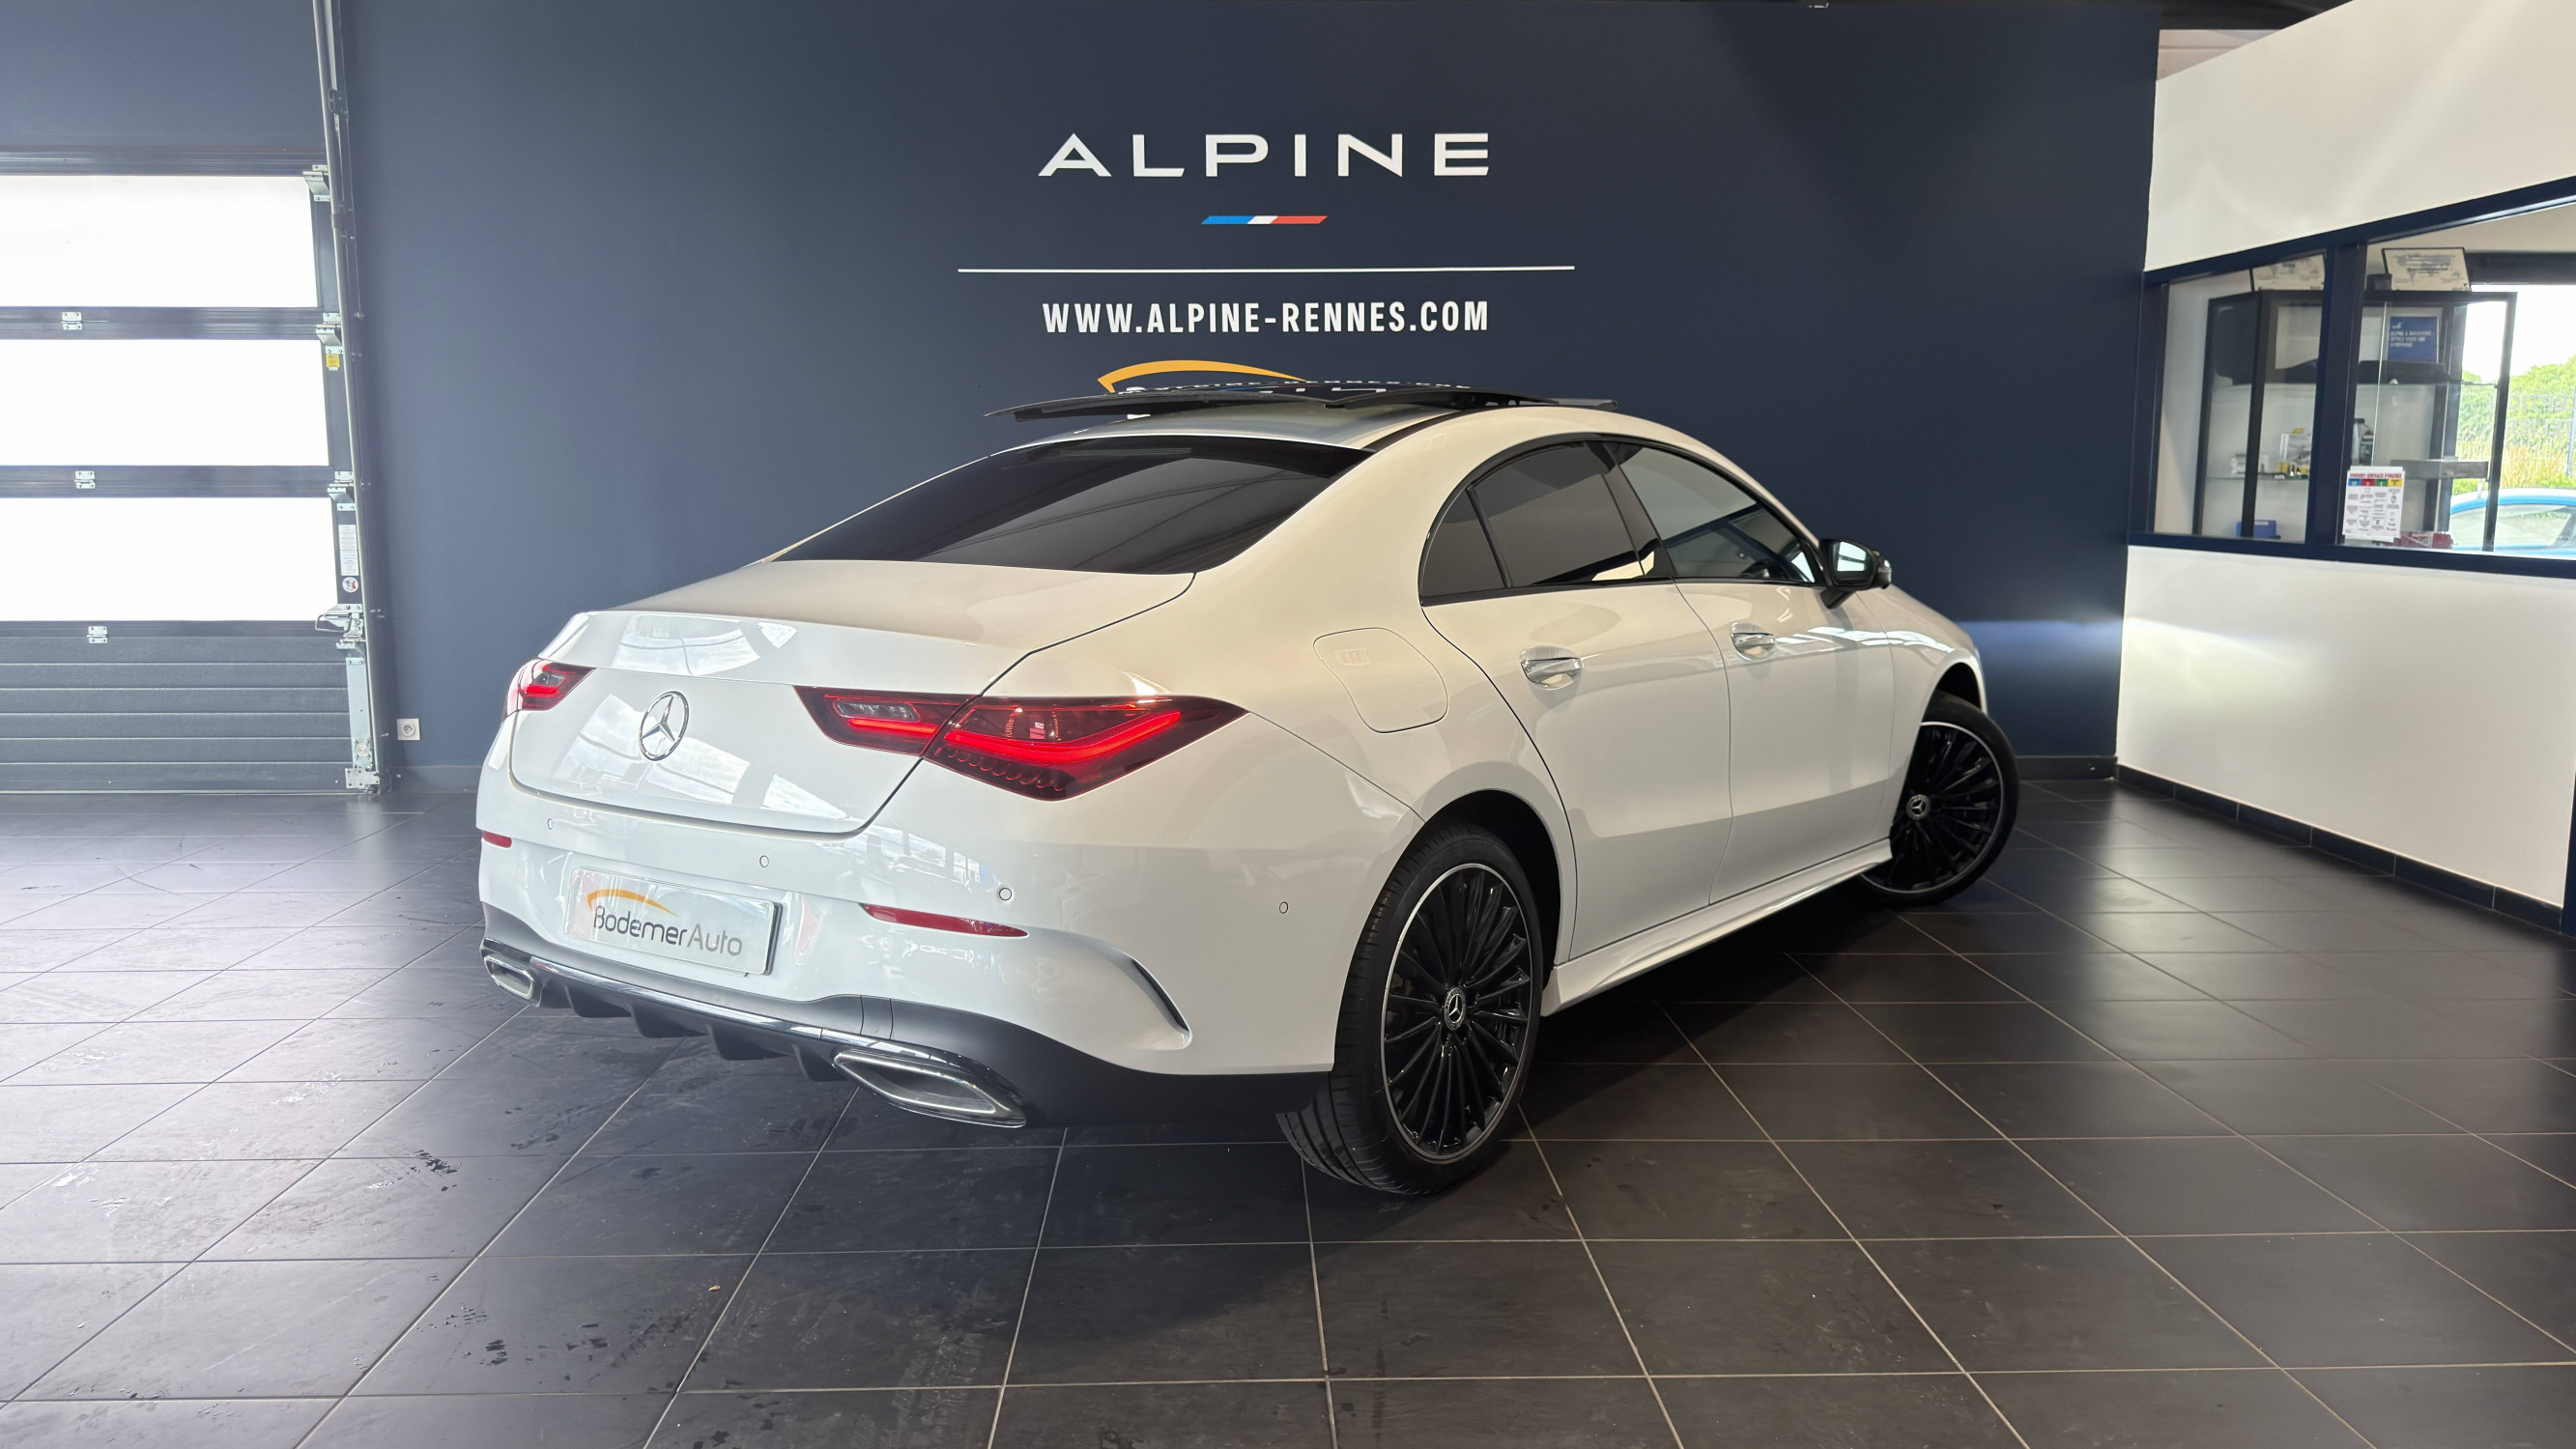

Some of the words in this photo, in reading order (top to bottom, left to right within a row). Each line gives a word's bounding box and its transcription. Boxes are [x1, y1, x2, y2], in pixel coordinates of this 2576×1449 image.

[1038, 132, 1490, 178] ALPINE
[1042, 300, 1488, 333] WWW.ALPINE-RENNES.COM
[592, 904, 743, 957] BodemerAuto
